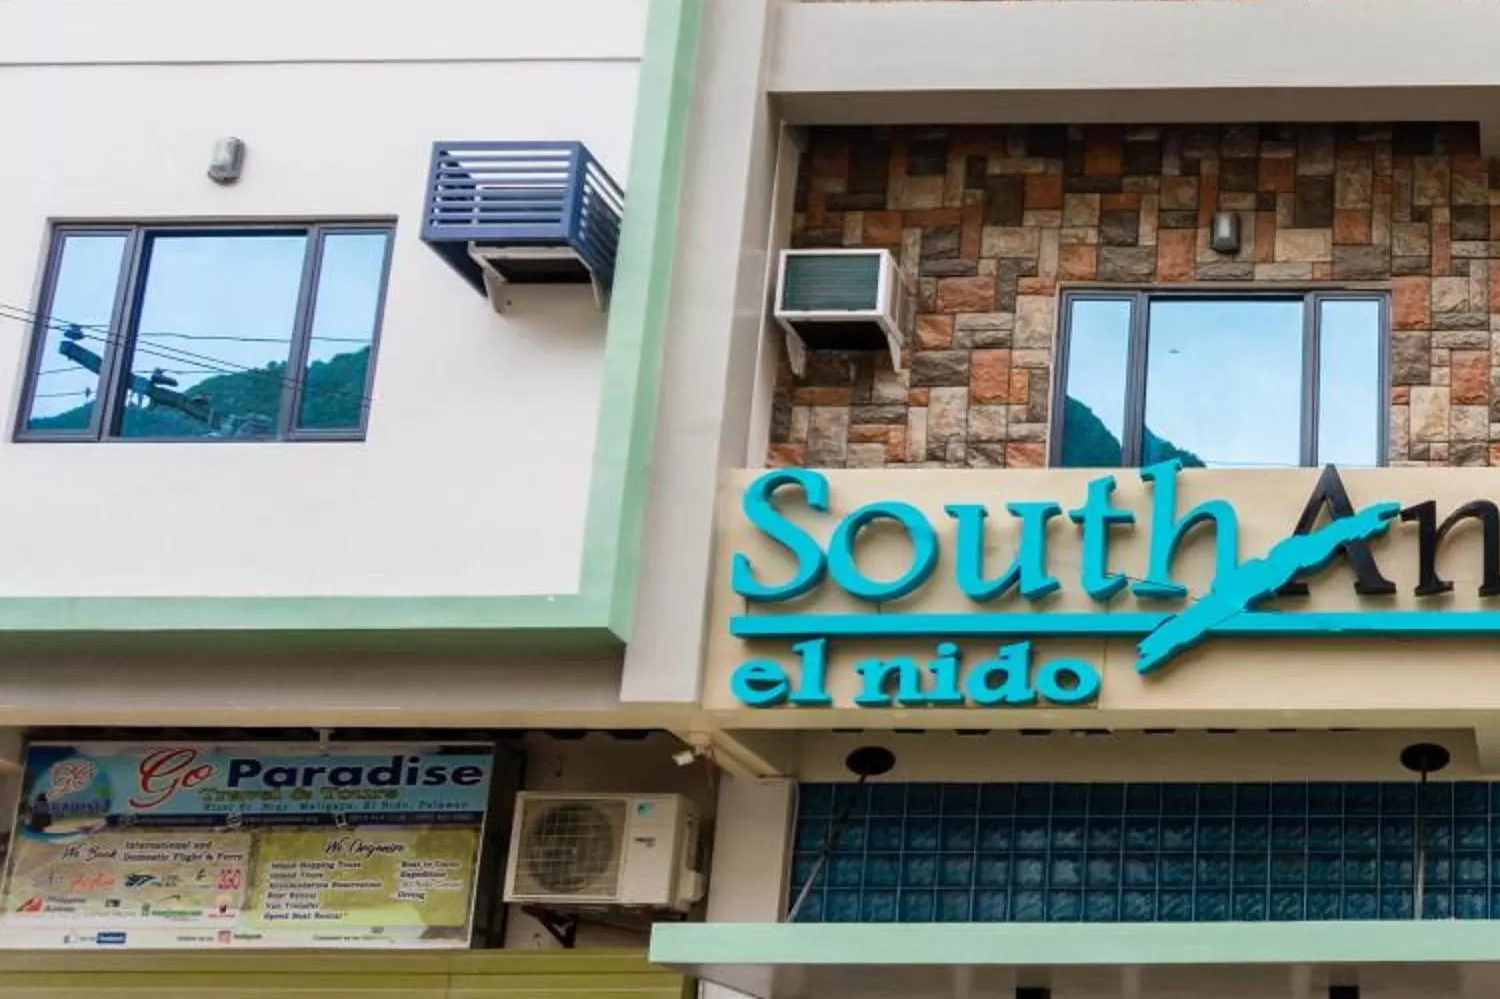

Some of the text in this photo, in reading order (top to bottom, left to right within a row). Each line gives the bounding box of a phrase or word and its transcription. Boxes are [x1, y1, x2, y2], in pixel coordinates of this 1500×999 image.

[731, 458, 1242, 602] South
[730, 638, 1101, 707] el nido
[128, 747, 484, 808] Go Paradise
